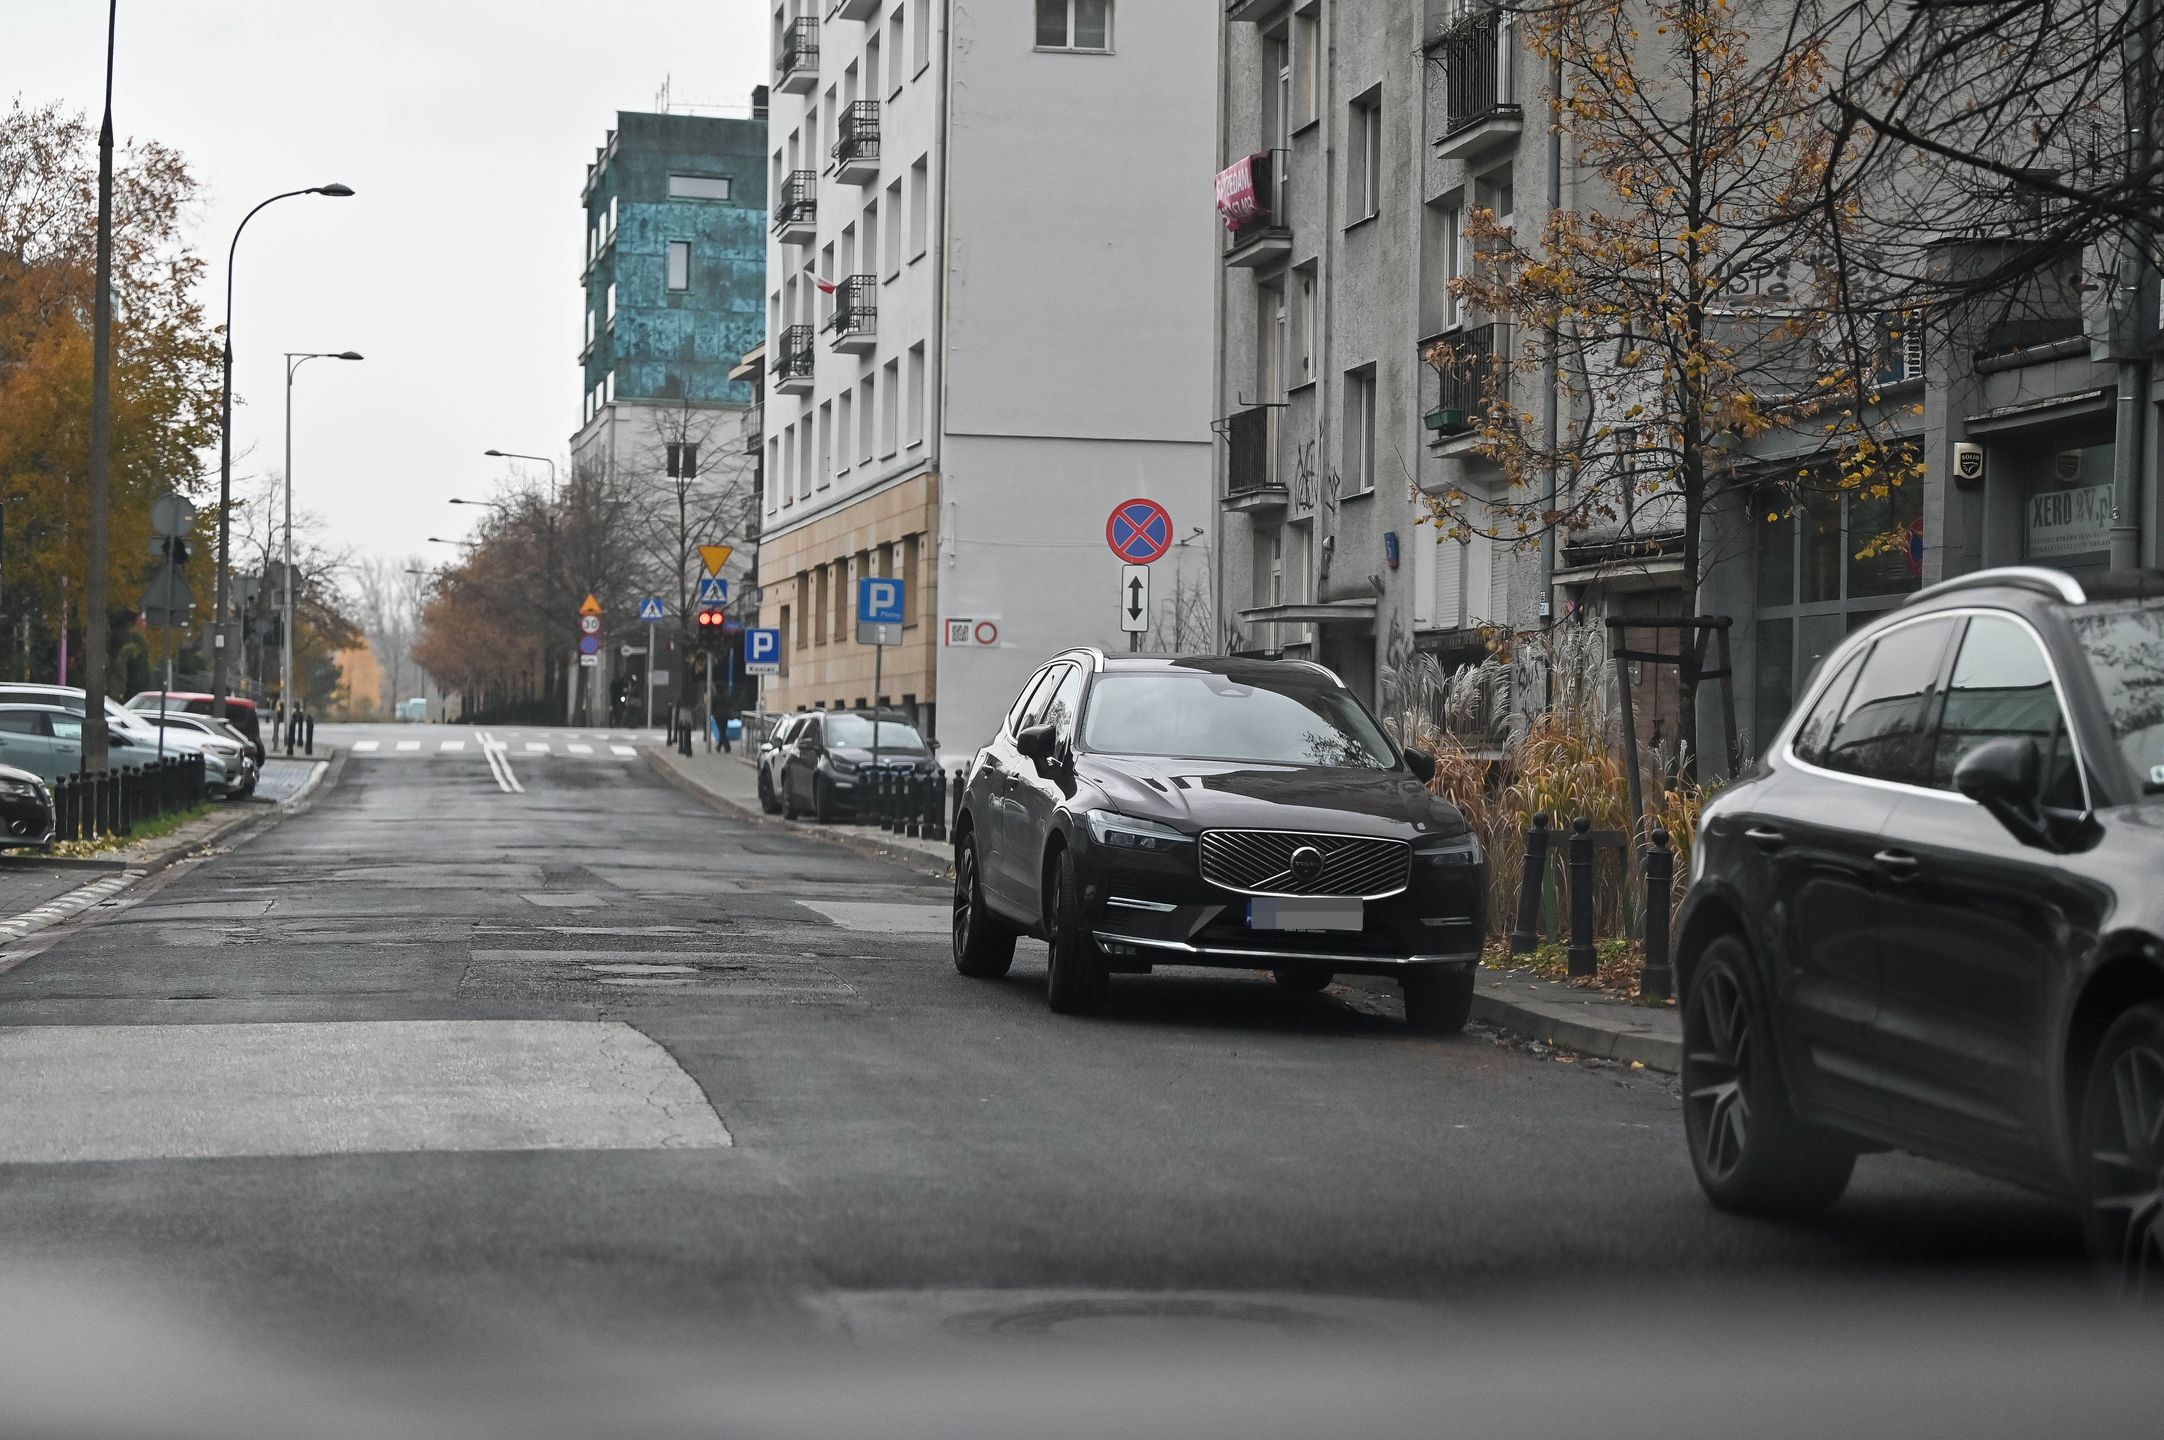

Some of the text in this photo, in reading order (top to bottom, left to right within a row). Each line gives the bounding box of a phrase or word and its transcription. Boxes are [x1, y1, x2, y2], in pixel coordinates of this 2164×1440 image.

[2033, 492, 2072, 528] XERO
[869, 582, 895, 617] P
[753, 631, 773, 659] P
